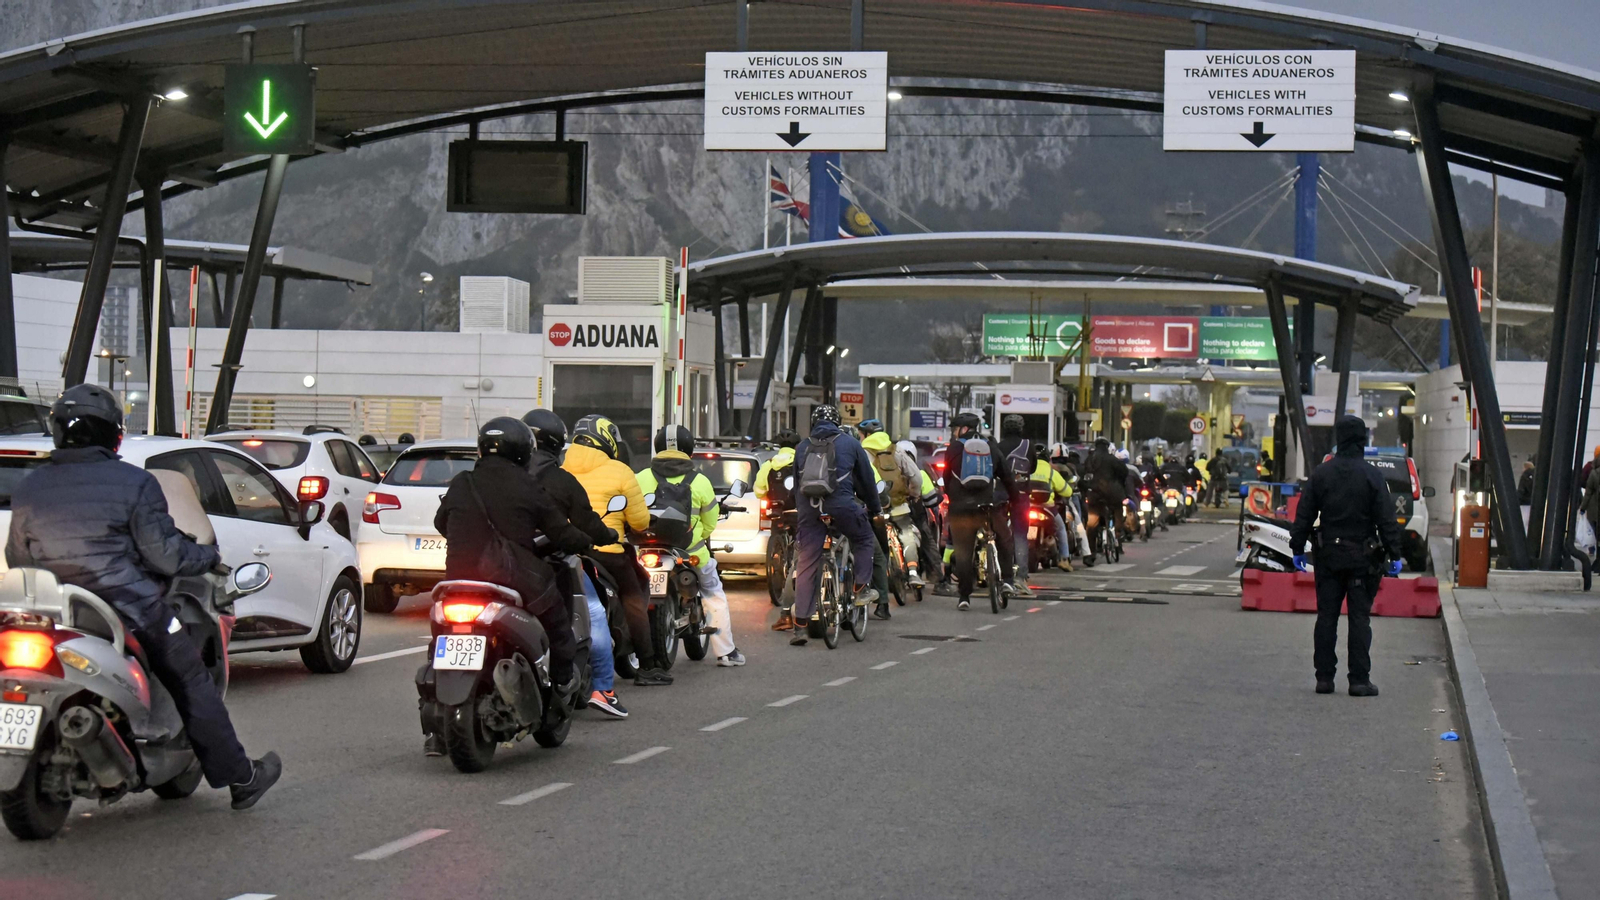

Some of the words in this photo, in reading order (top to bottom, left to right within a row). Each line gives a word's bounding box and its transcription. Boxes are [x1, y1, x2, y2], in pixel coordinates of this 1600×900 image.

[748, 55, 818, 66] VEHÍCULOS
[822, 57, 842, 66] SIN
[1206, 53, 1280, 64] VEHÍCULOS
[1284, 55, 1312, 64] CON
[724, 68, 784, 79] TRÁMITES
[789, 70, 867, 79] ADUANEROS
[1184, 66, 1248, 78] TRÁMITES
[1252, 68, 1334, 78] ADUANEROS
[734, 91, 794, 100] VEHICLES
[798, 91, 853, 100] WITHOUT
[1208, 90, 1270, 100] VEHICLES
[1274, 90, 1306, 100] WITH
[722, 106, 780, 116] CUSTOMS
[784, 106, 865, 116] FORMALITIES
[1182, 106, 1244, 116] CUSTOMS
[1248, 106, 1333, 116] FORMALITIES
[572, 324, 659, 348] ADUANA
[1193, 421, 1203, 429] 10
[446, 638, 482, 652] 3838
[450, 652, 477, 666] JZF
[0, 708, 36, 726] 693
